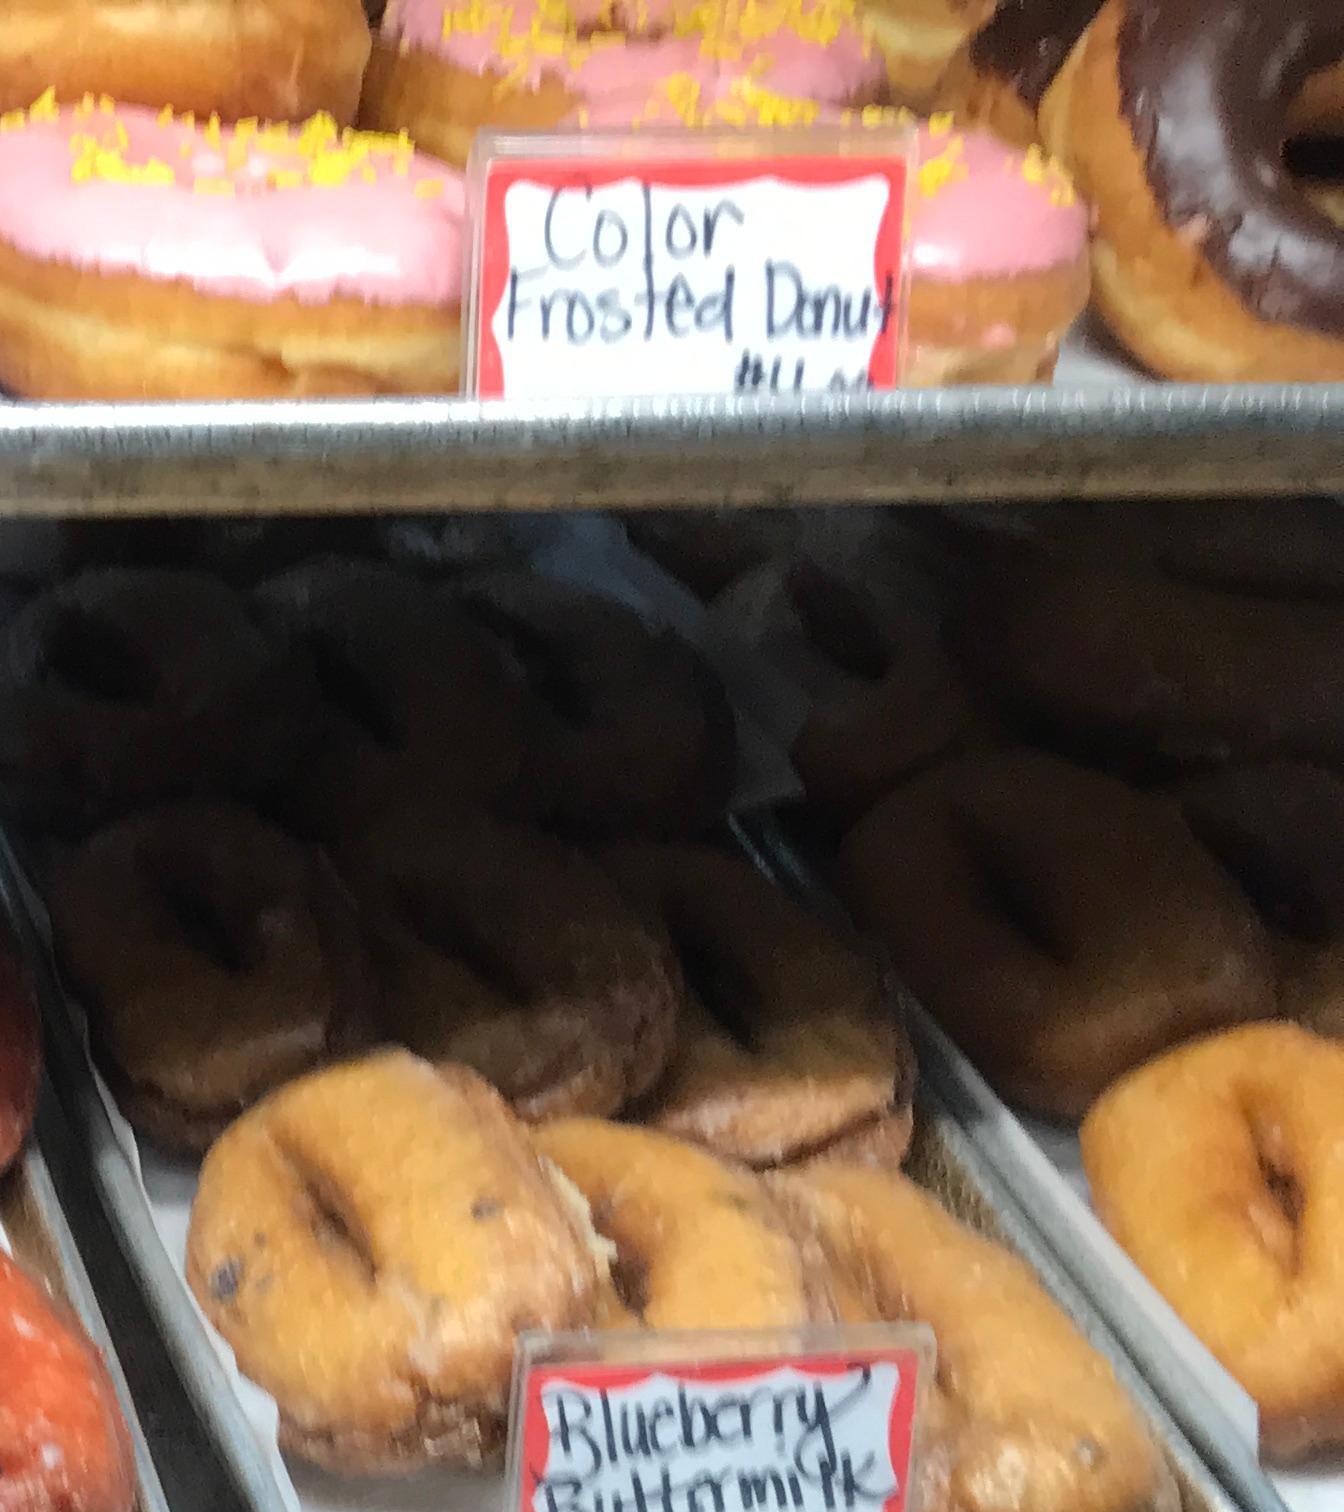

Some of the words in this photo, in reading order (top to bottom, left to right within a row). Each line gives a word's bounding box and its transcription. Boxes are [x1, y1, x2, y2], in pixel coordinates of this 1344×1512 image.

[544, 180, 744, 270] Color
[506, 260, 735, 346] Frosted
[542, 1361, 872, 1483] Blueberry
